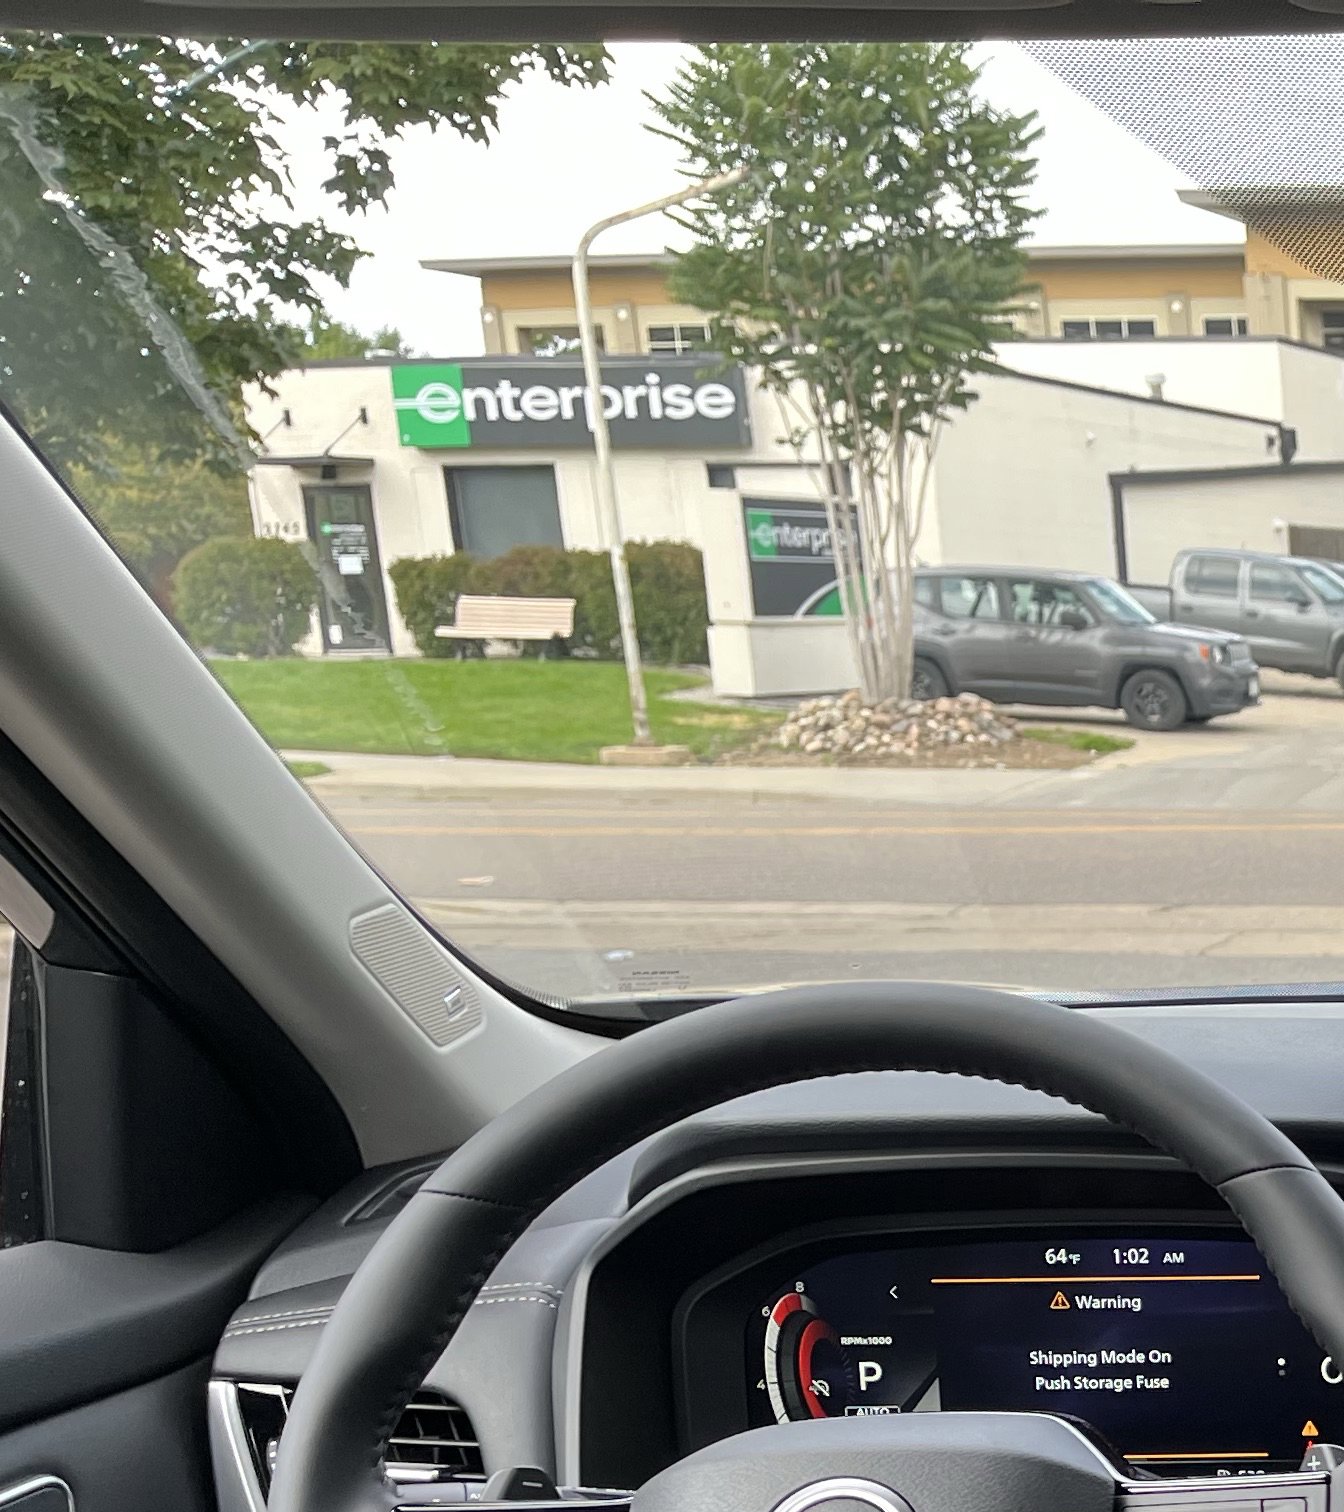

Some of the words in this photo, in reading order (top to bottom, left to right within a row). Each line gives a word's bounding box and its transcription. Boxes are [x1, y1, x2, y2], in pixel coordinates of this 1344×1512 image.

[415, 372, 736, 433] enterprise
[1113, 1248, 1150, 1265] 1:02
[1162, 1252, 1185, 1264] AM
[795, 1281, 805, 1293] 8
[761, 1305, 770, 1317] 6
[1074, 1295, 1142, 1312] Warning
[1029, 1350, 1097, 1368] Shipping
[1101, 1349, 1145, 1364] Mode
[1148, 1350, 1172, 1364] On
[858, 1361, 883, 1391] P
[1035, 1375, 1071, 1391] Push
[1073, 1376, 1133, 1393] Storage
[1136, 1375, 1170, 1390] Fuse
